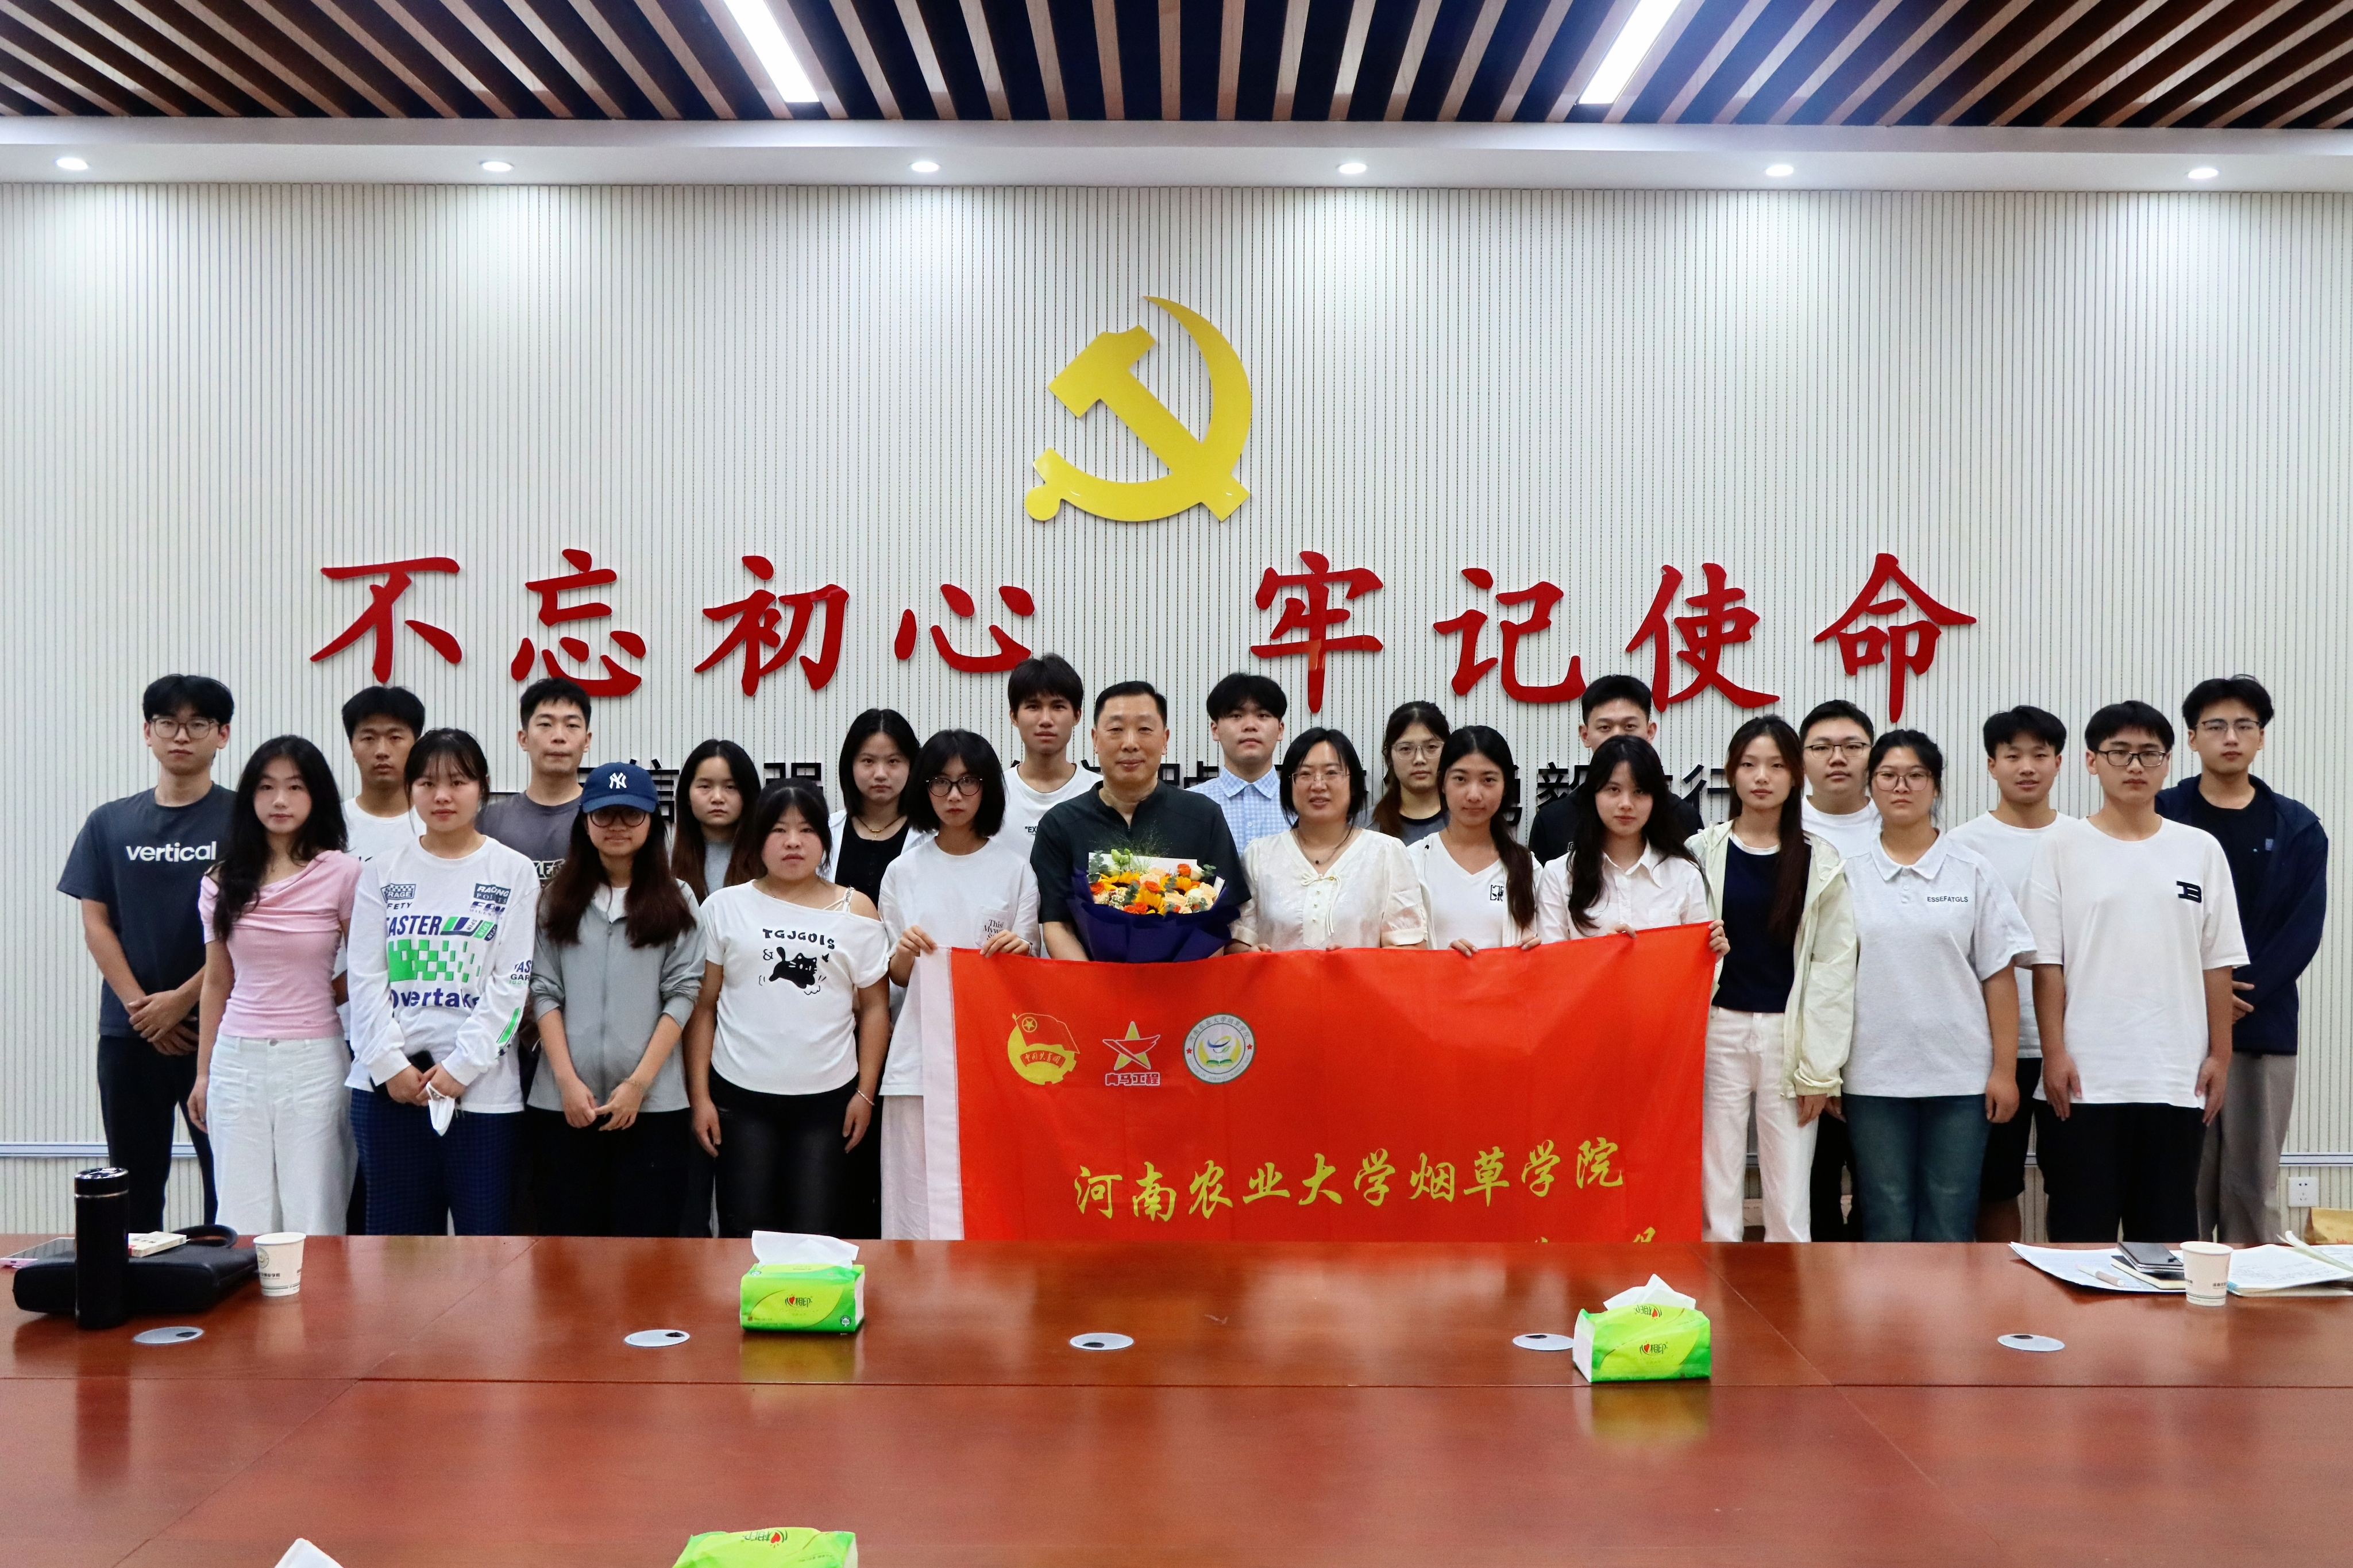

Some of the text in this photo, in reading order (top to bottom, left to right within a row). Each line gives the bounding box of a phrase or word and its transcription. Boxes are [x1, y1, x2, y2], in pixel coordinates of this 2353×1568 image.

[310, 549, 1977, 723] 不忘初心 牢记使命
[609, 772, 627, 789] NY
[126, 841, 217, 862] vertical
[387, 902, 412, 910] FETY
[386, 916, 443, 936] ASTER
[478, 922, 490, 936] SPIN
[1074, 1137, 1623, 1222] 河南农业大学烟草学院
[785, 1295, 812, 1308] 心相印
[1640, 1343, 1668, 1356] 心相印
